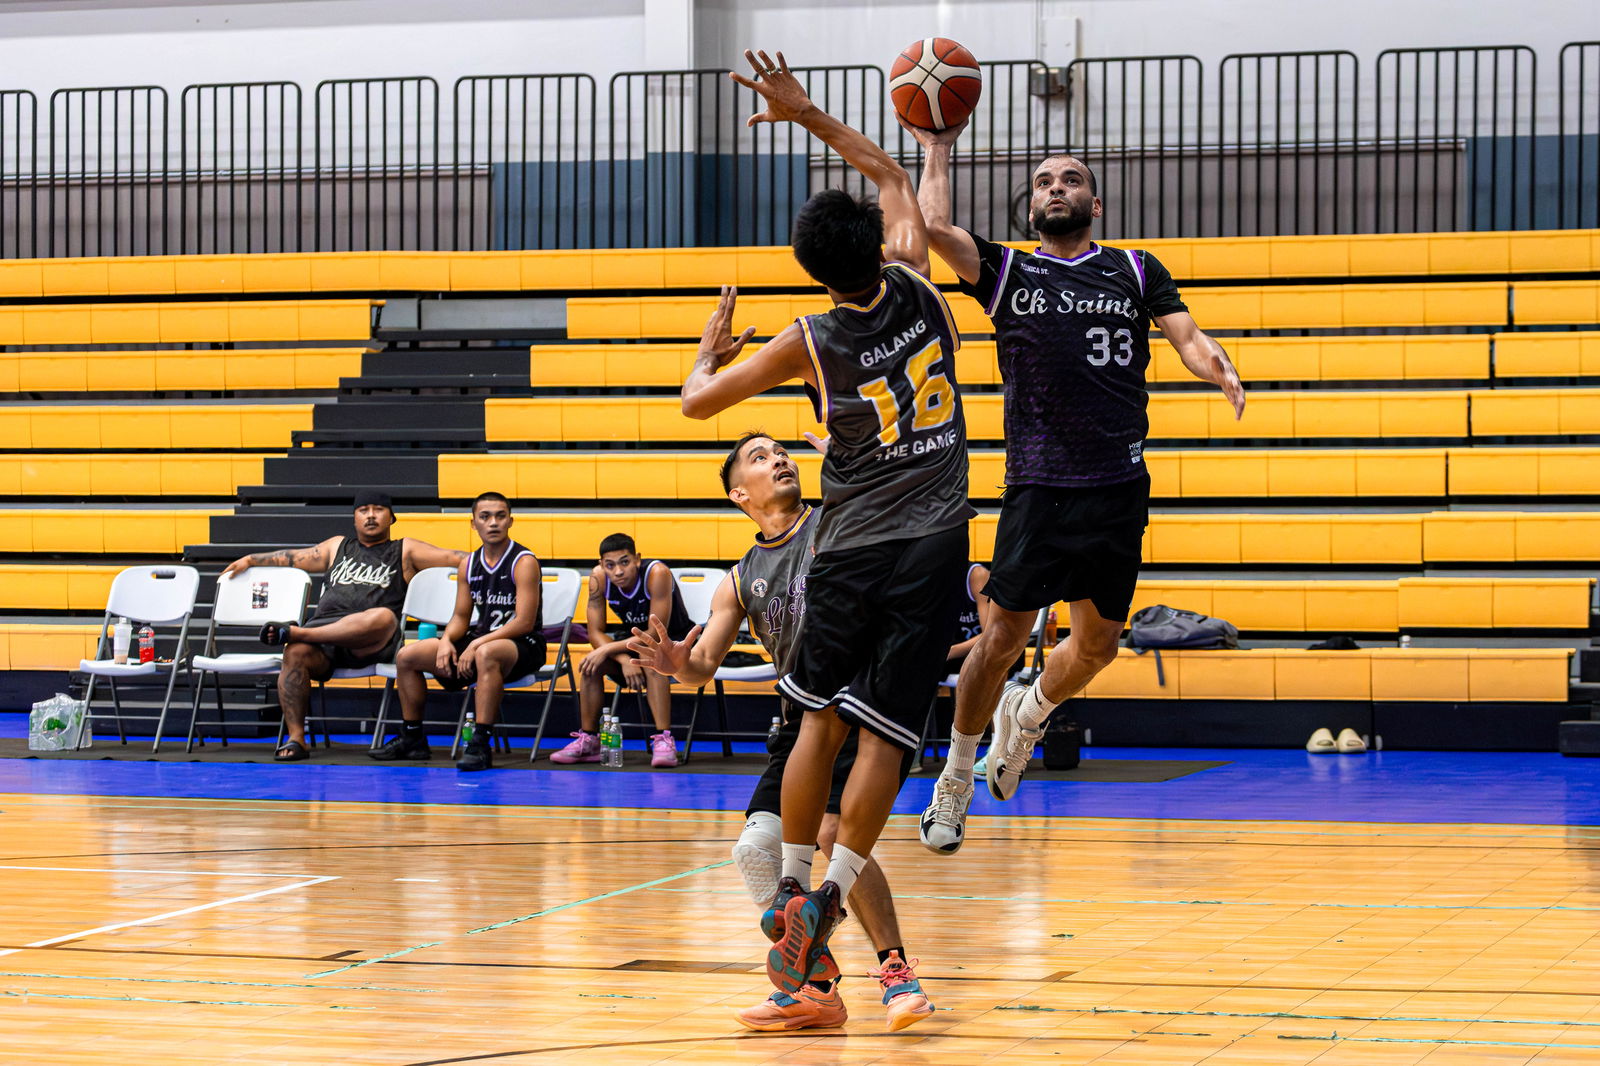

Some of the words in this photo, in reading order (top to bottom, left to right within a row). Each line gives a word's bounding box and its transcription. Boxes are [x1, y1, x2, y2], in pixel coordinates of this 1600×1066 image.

[1011, 288, 1048, 315] Ck
[860, 320, 927, 367] GALANG
[1085, 327, 1134, 366] 33
[857, 336, 956, 447] 16
[912, 429, 957, 455] GAME
